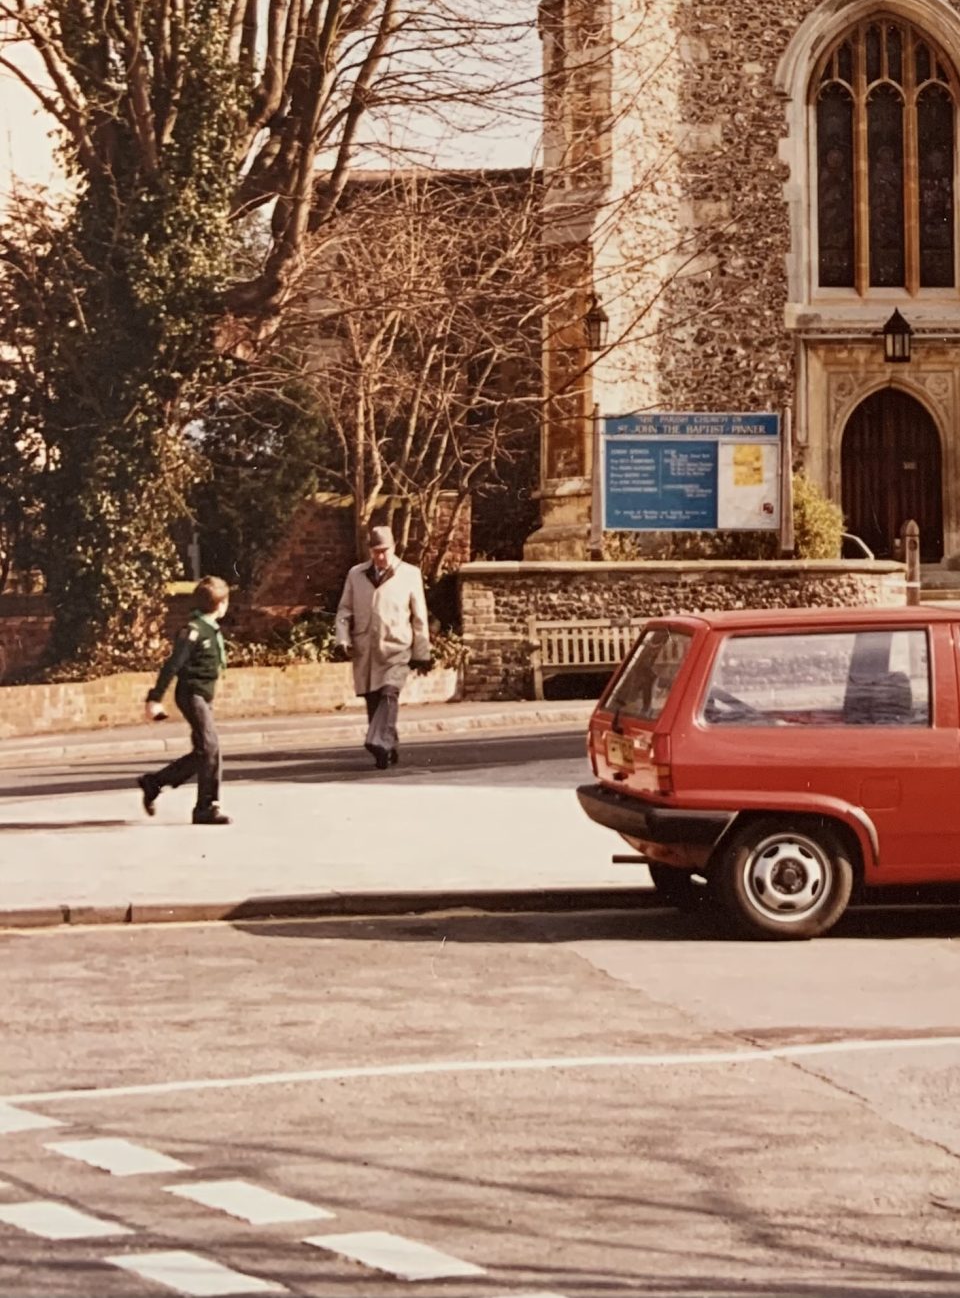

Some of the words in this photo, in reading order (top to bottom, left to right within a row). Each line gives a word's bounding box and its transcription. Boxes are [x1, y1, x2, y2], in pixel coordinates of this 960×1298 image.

[633, 425, 657, 434] JOHN
[663, 425, 680, 434] THE
[686, 424, 725, 434] BAPTIST
[731, 425, 767, 434] PINNER
